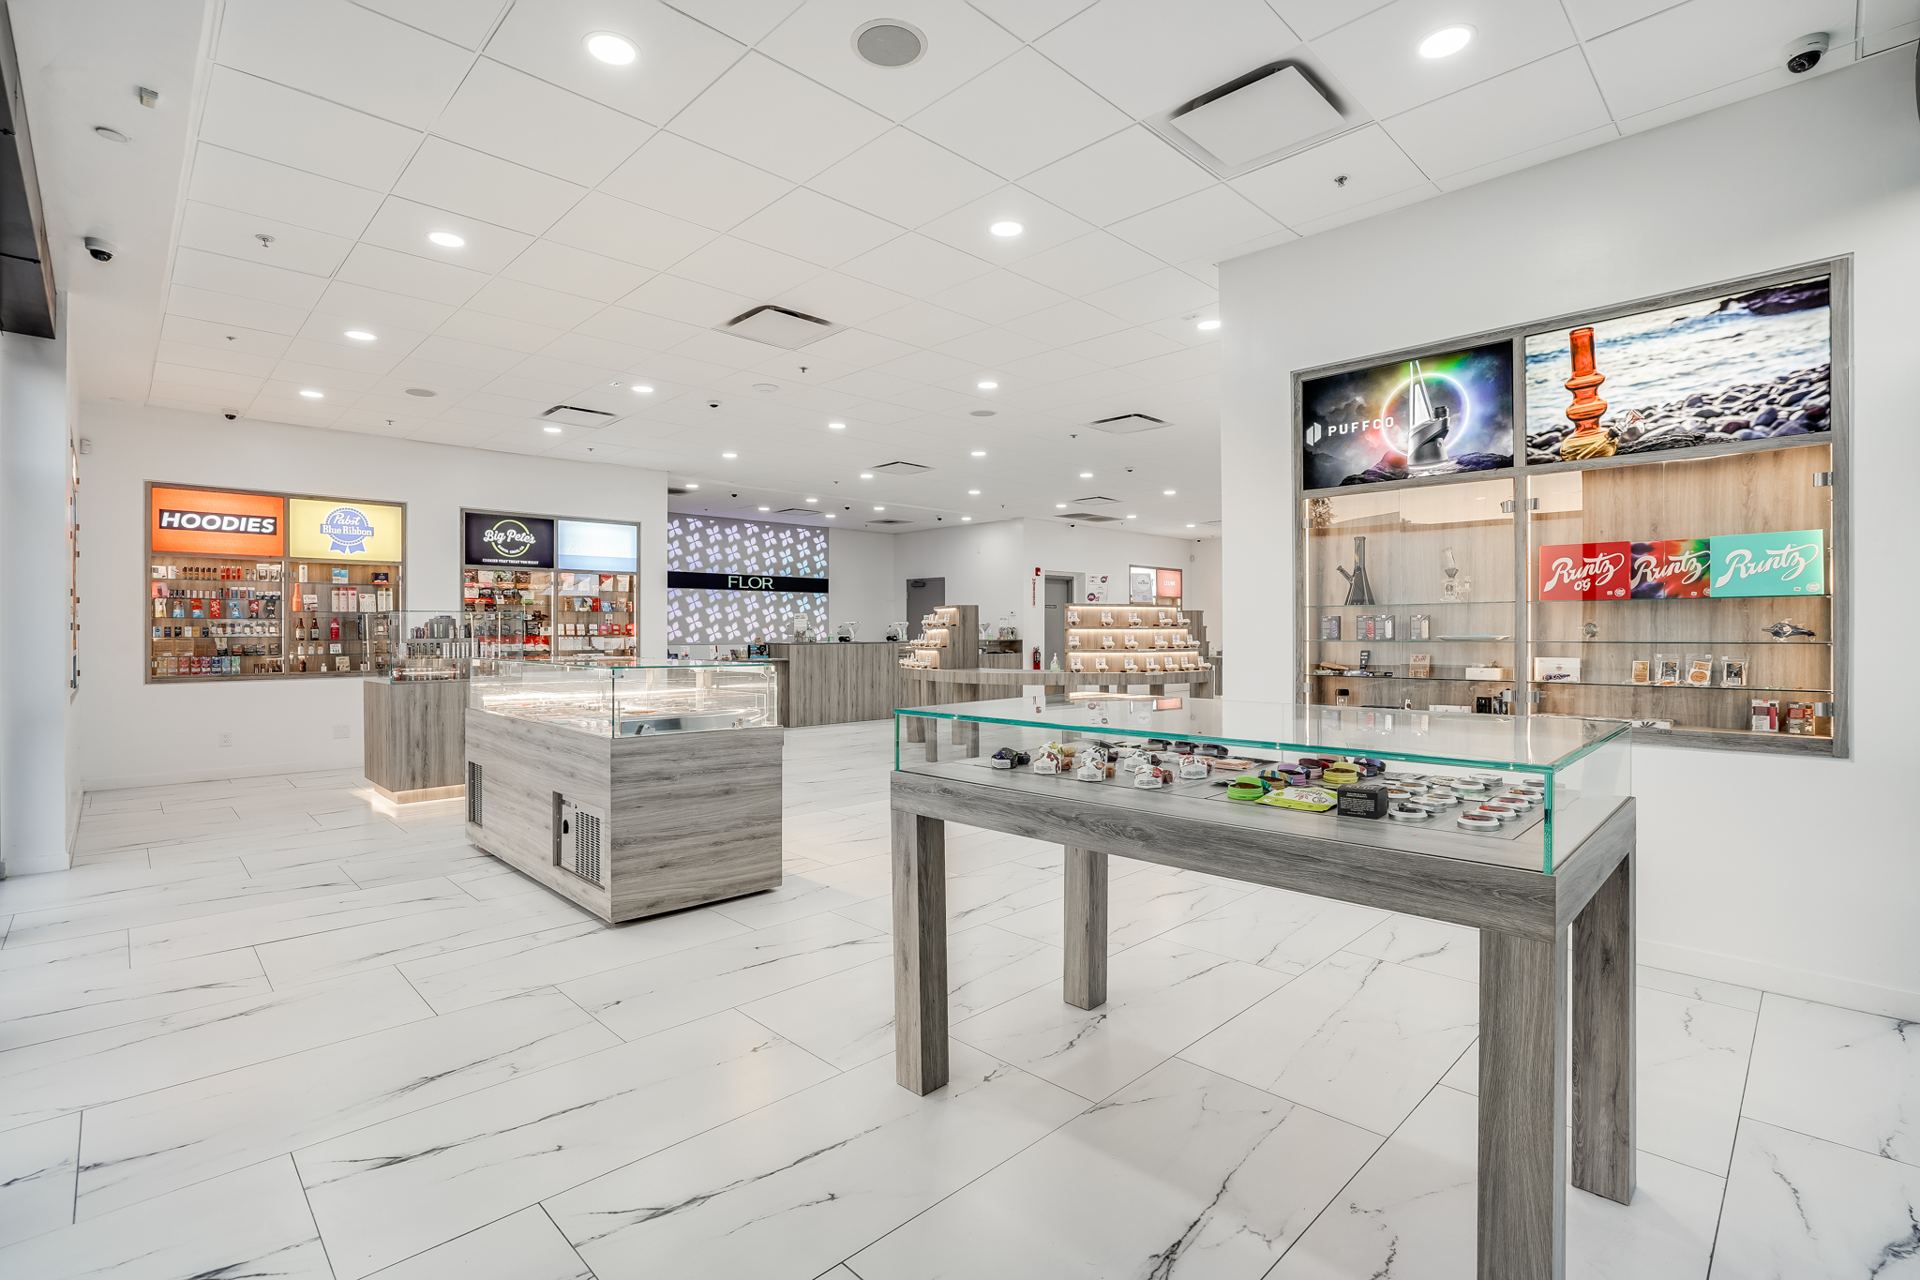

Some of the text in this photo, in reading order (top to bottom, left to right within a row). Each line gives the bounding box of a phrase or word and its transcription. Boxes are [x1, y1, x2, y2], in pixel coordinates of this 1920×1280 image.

[1327, 416, 1395, 437] PUFFCO
[161, 511, 275, 534] HOODIES
[333, 512, 361, 526] Pabst
[322, 524, 372, 537] Blue Ribbon
[483, 529, 536, 545] Big Pete's
[1543, 552, 1625, 593] Runtz
[1631, 550, 1711, 590] Runtz
[1714, 543, 1820, 589] Runtz
[728, 575, 774, 590] FLOR
